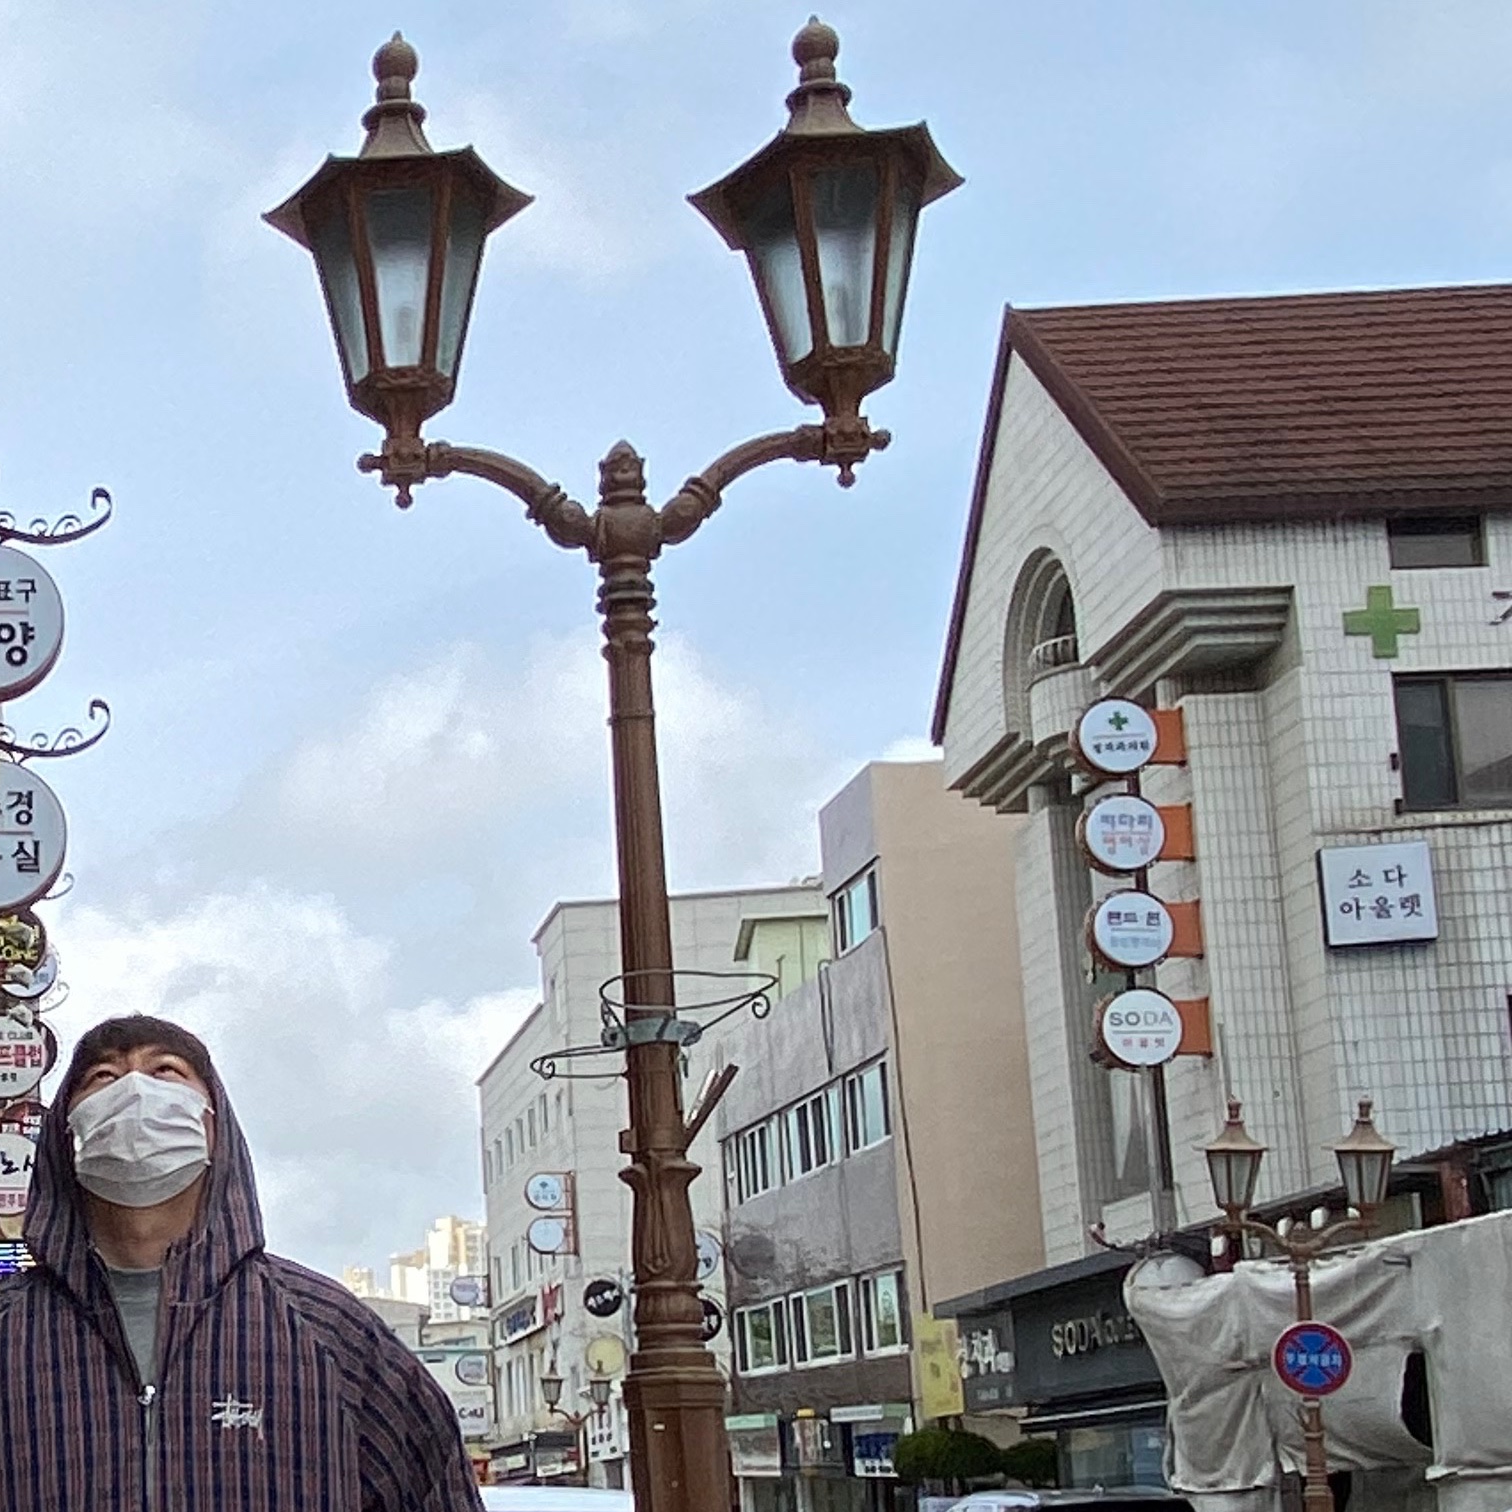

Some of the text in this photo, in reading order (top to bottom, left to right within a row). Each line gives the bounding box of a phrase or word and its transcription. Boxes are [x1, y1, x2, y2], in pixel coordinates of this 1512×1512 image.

[1348, 864, 1408, 888] 소다
[1339, 893, 1424, 921] 아울렛
[1109, 1011, 1174, 1027] SODA
